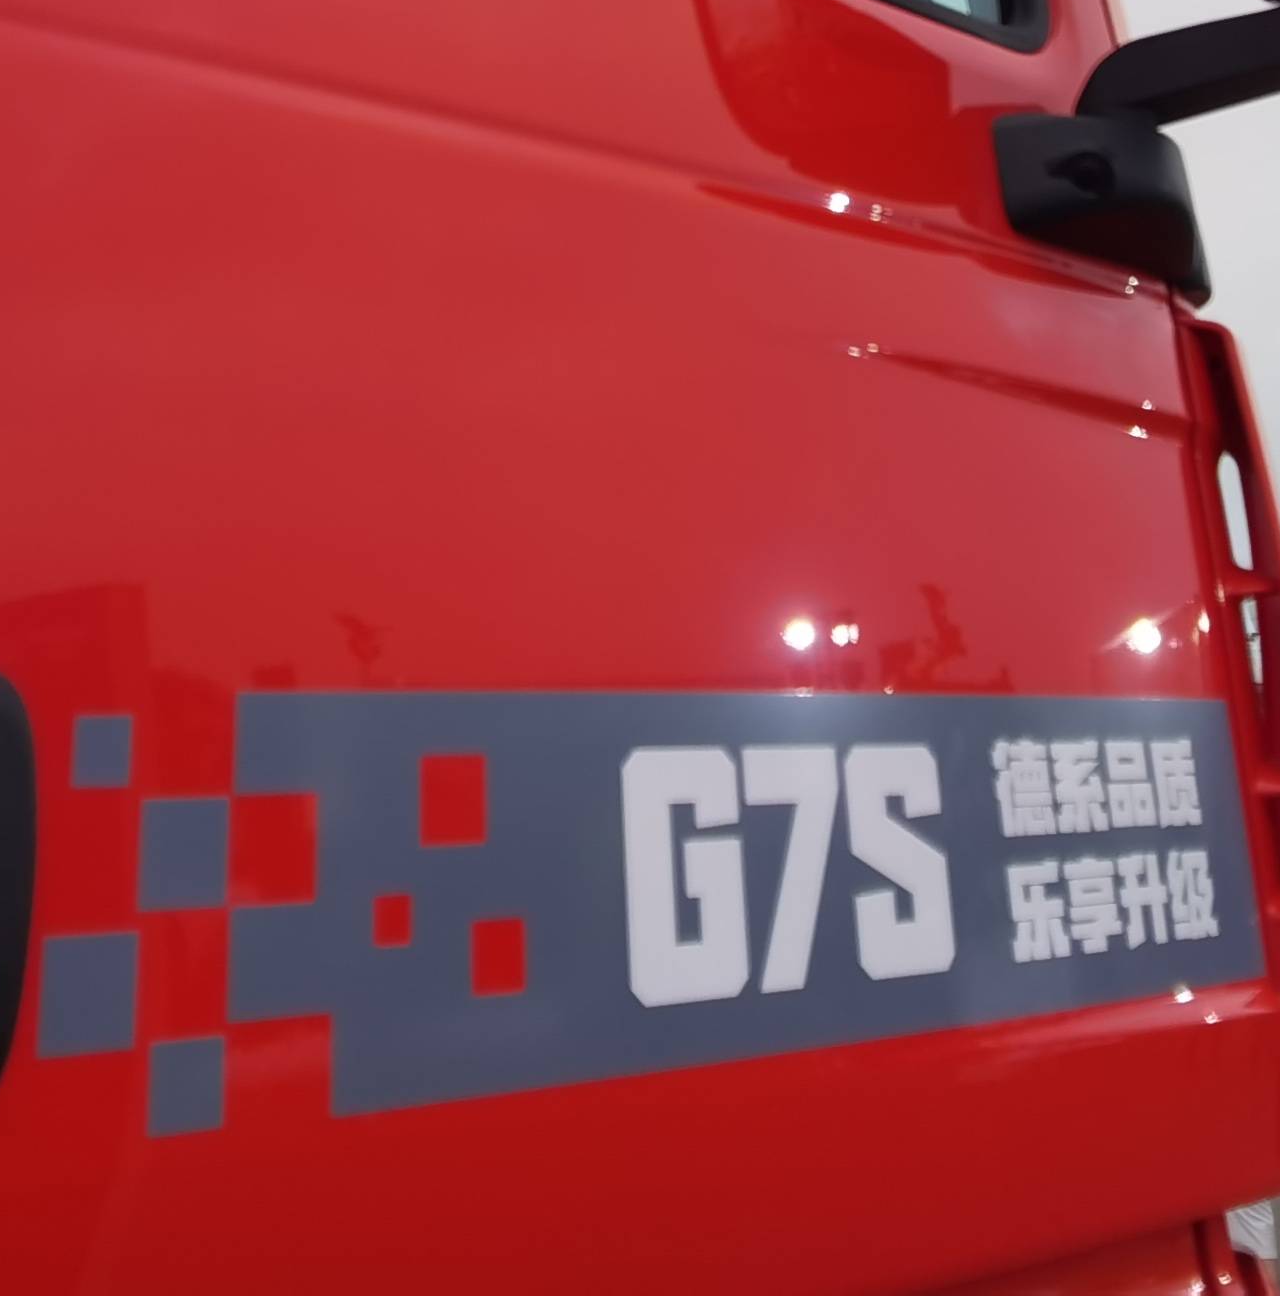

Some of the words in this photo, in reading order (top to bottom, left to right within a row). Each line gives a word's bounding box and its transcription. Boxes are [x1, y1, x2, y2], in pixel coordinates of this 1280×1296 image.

[991, 738, 1202, 837] 德系品质
[622, 743, 955, 1007] G7S
[1007, 849, 1218, 963] 乐享升级
